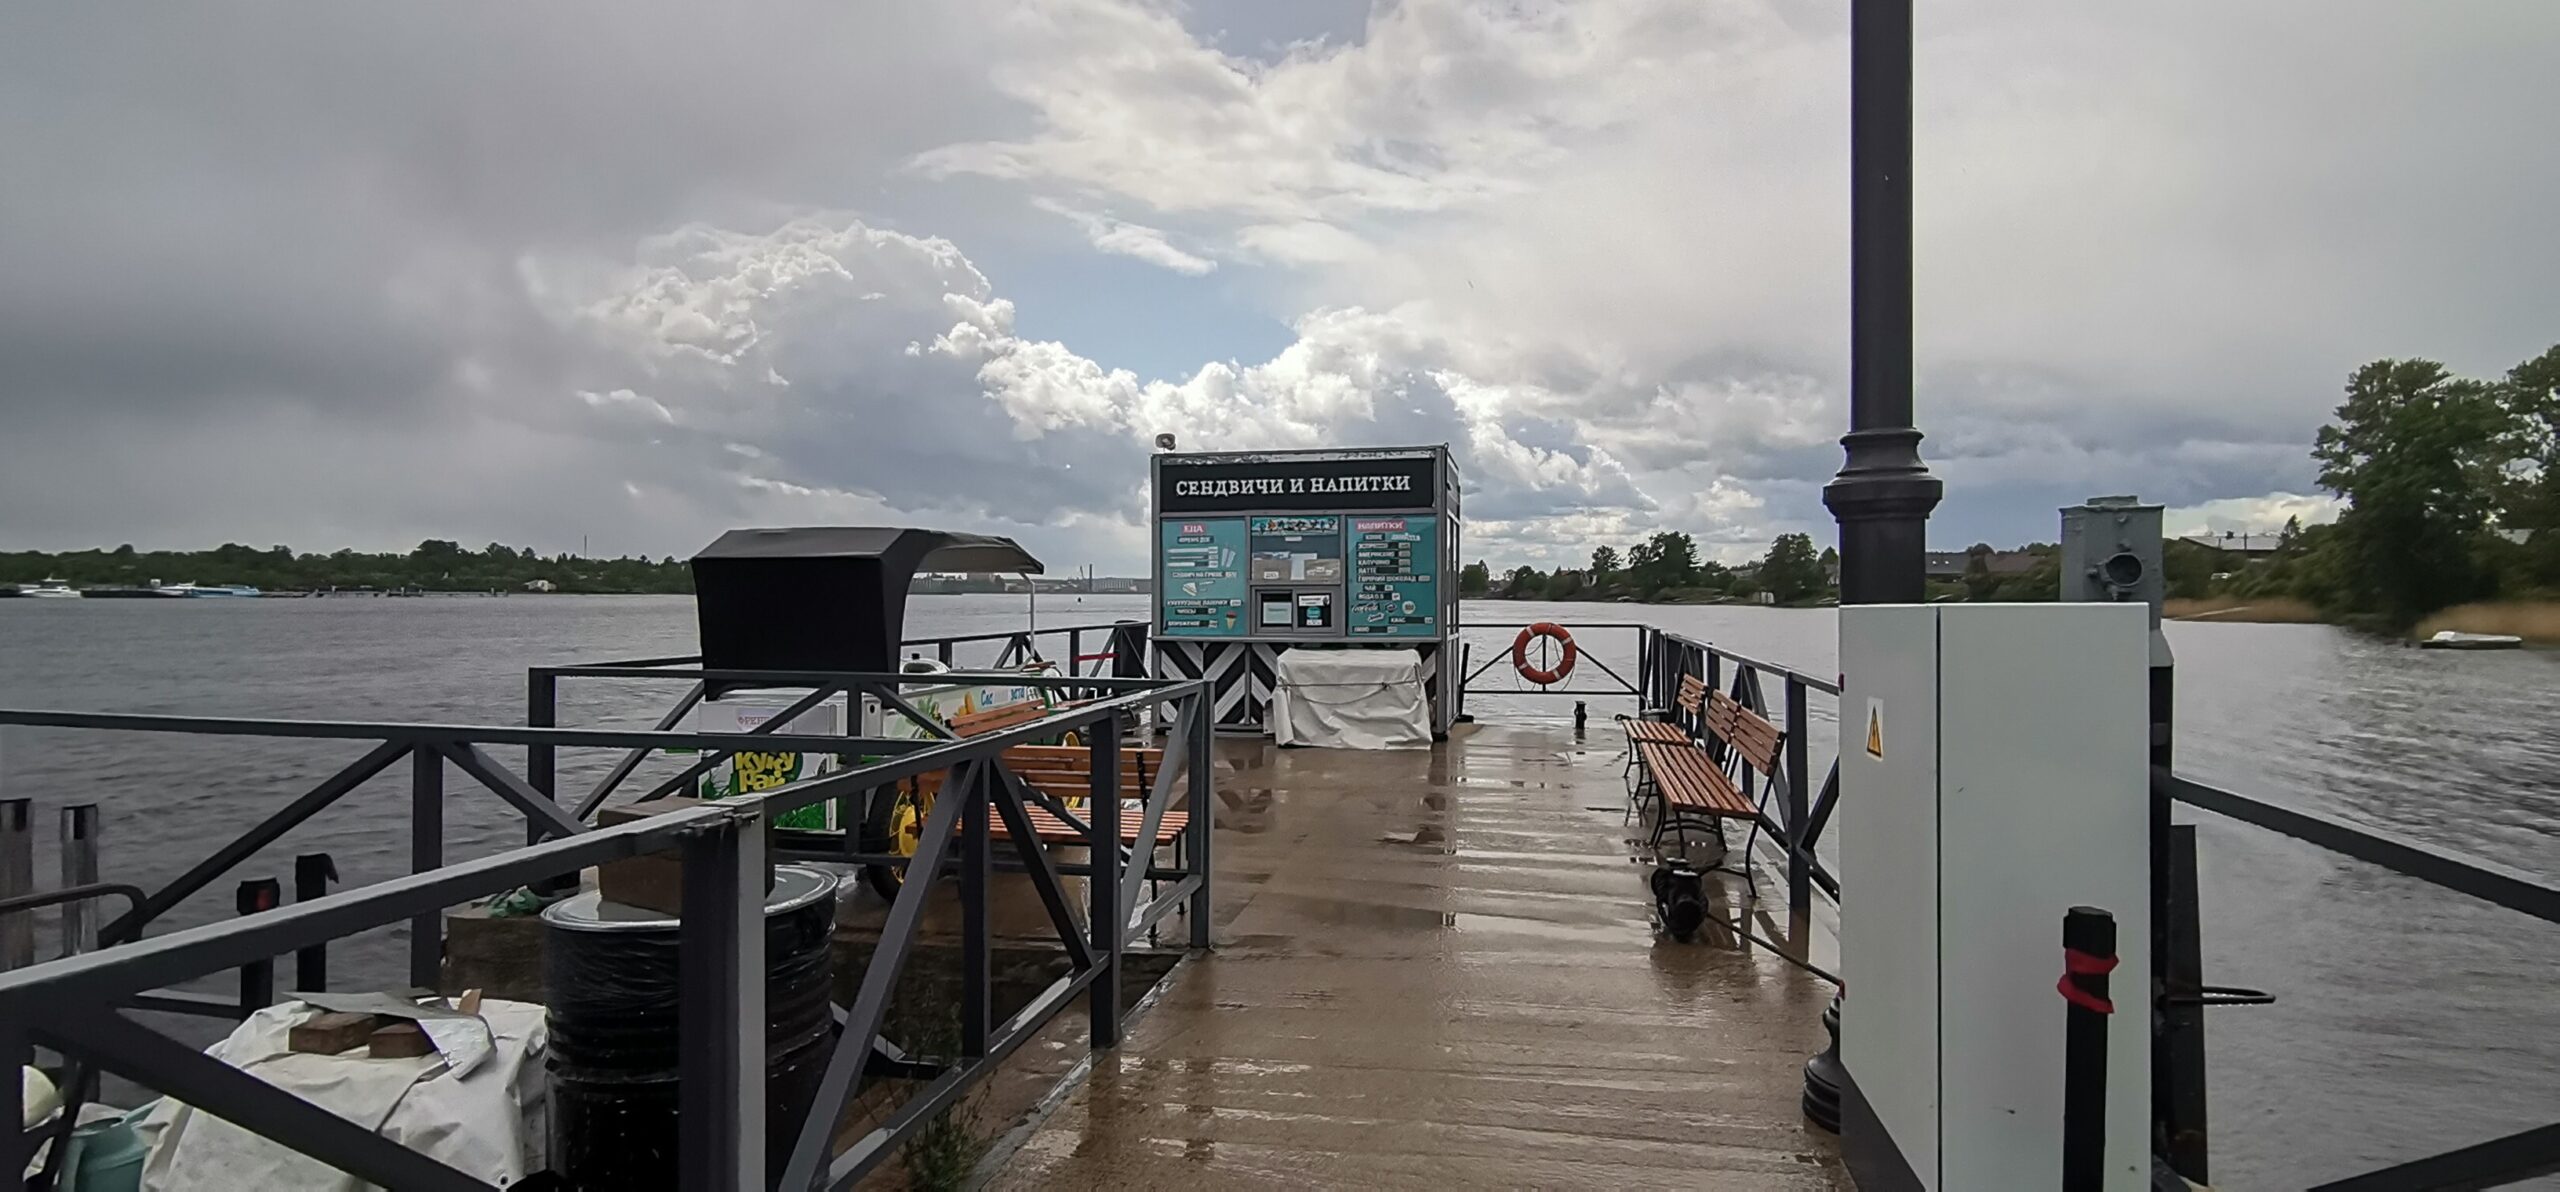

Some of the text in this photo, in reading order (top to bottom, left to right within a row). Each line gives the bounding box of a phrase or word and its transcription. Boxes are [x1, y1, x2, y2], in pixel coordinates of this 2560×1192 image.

[1176, 475, 1411, 497] СЕНДВИЧИ И НАПИТКИ
[1357, 521, 1404, 530] НАПИТКИ
